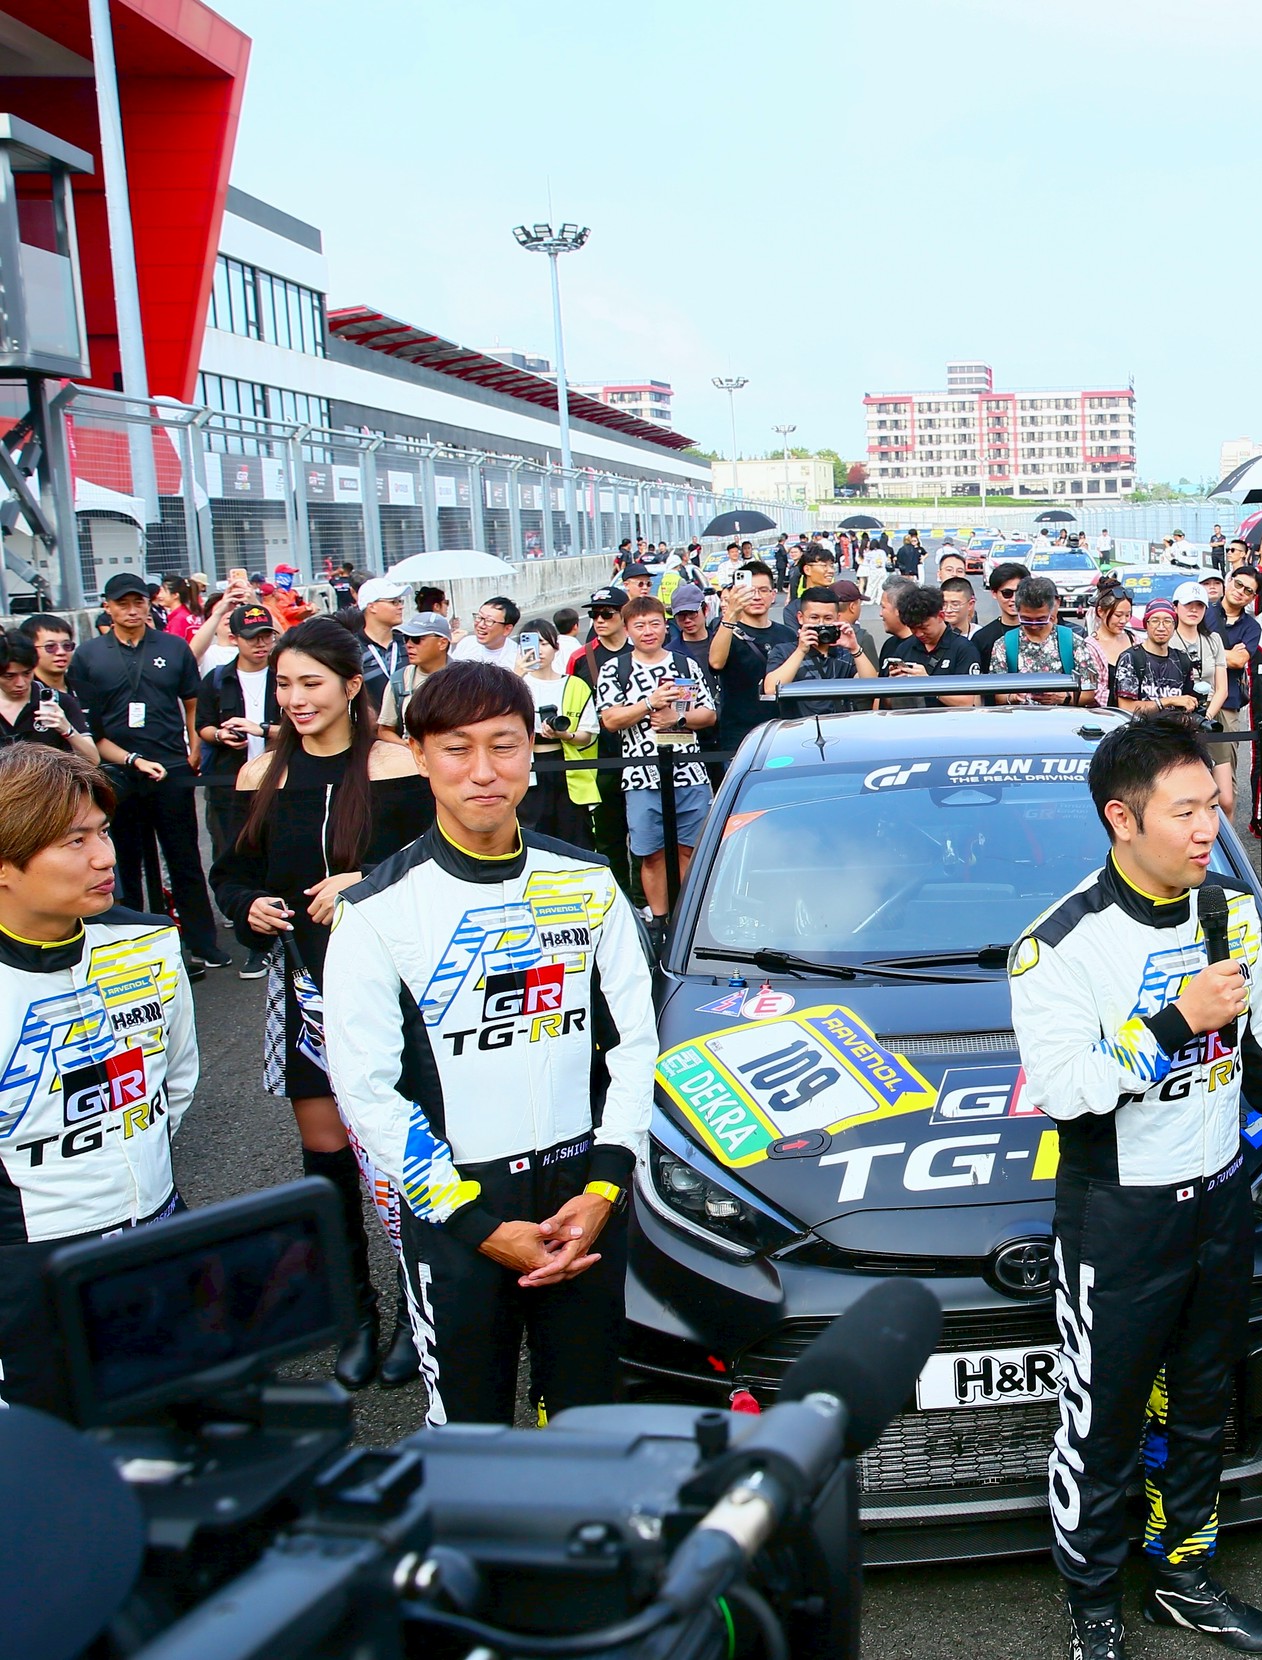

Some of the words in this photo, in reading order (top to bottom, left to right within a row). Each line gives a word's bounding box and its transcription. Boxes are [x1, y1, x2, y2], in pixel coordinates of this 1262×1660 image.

[1125, 577, 1152, 588] 86
[947, 758, 1037, 776] GRAN
[949, 775, 981, 785] THE
[983, 774, 1023, 783] REAL
[1025, 773, 1086, 783] DRIVING
[538, 904, 580, 916] RAVENOL
[540, 930, 572, 949] H&R
[107, 978, 150, 996] RAVENOL
[485, 981, 562, 1020] GR
[110, 1008, 145, 1032] H&R
[753, 996, 783, 1014] E
[442, 1007, 586, 1057] TG-RR
[820, 1016, 904, 1093] RAVENOL
[736, 1039, 841, 1112] 109
[66, 1068, 145, 1122] GR
[678, 1069, 758, 1154] DEKRA
[16, 1093, 165, 1168] TG-RR
[955, 1351, 1060, 1404] H&R
